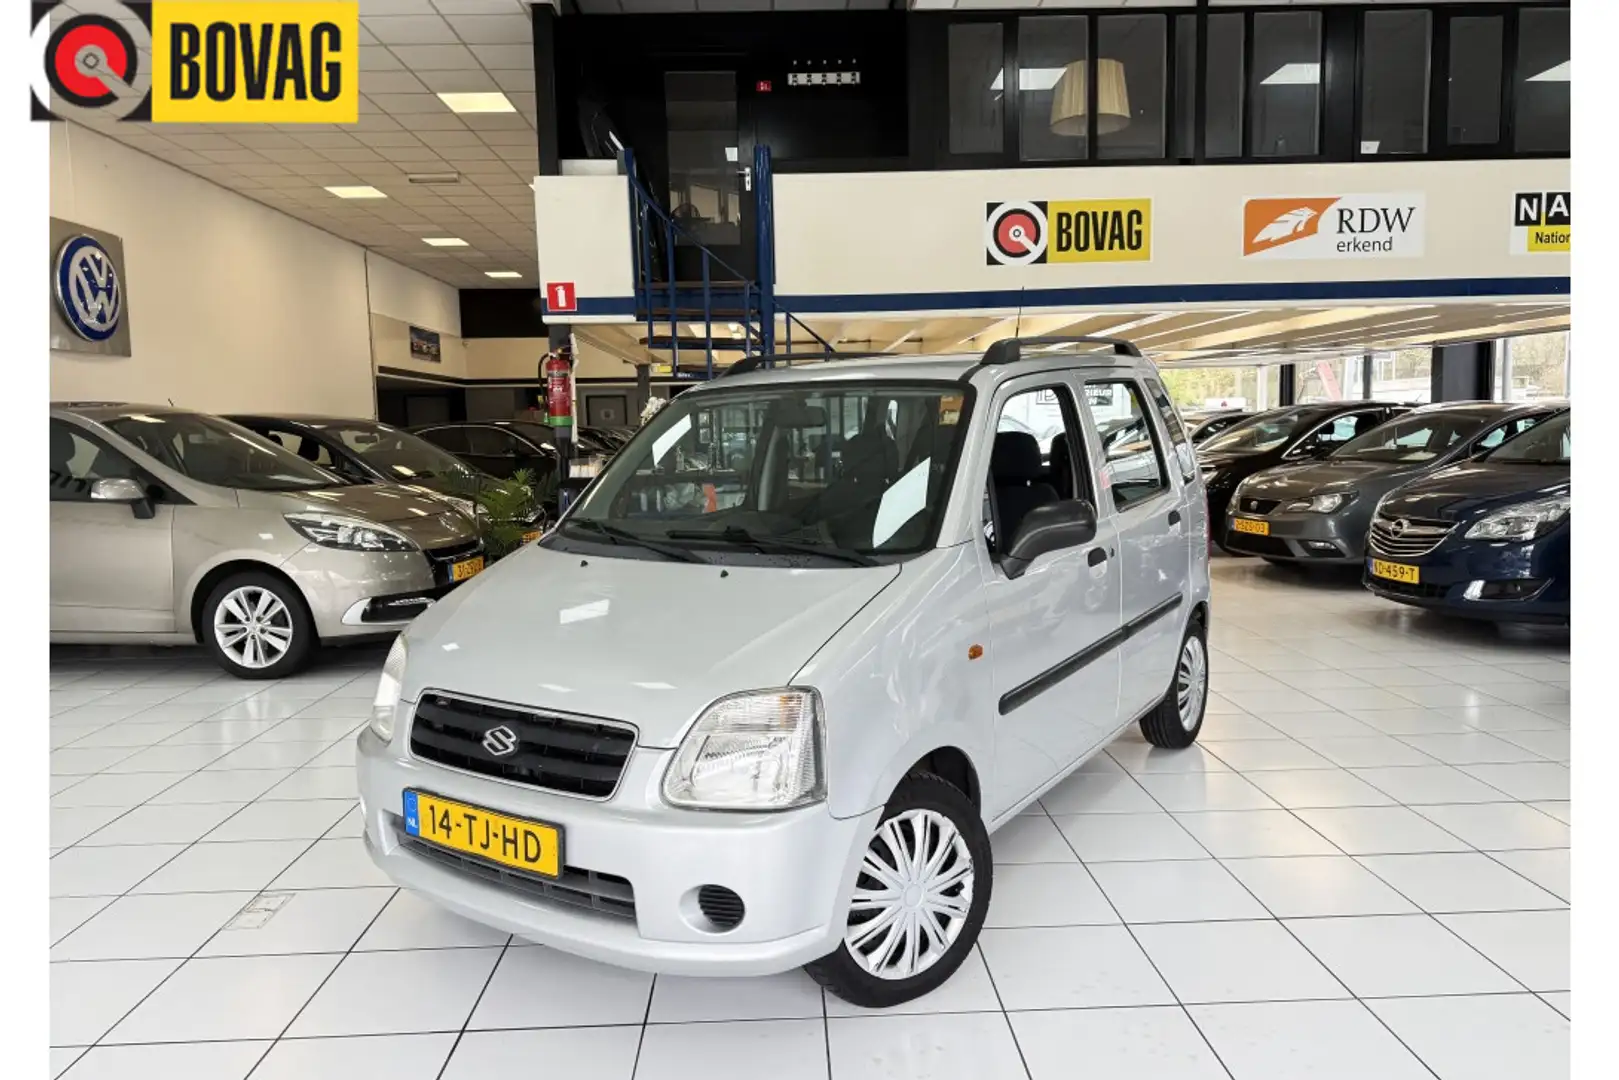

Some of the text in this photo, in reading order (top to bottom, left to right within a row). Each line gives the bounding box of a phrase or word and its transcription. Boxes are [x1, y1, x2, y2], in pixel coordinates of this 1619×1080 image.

[1056, 209, 1143, 252] BOVAG
[1336, 207, 1416, 234] RDW
[1336, 236, 1393, 252] erkend
[407, 817, 418, 828] NL
[429, 804, 541, 863] 14-TJ-HD
